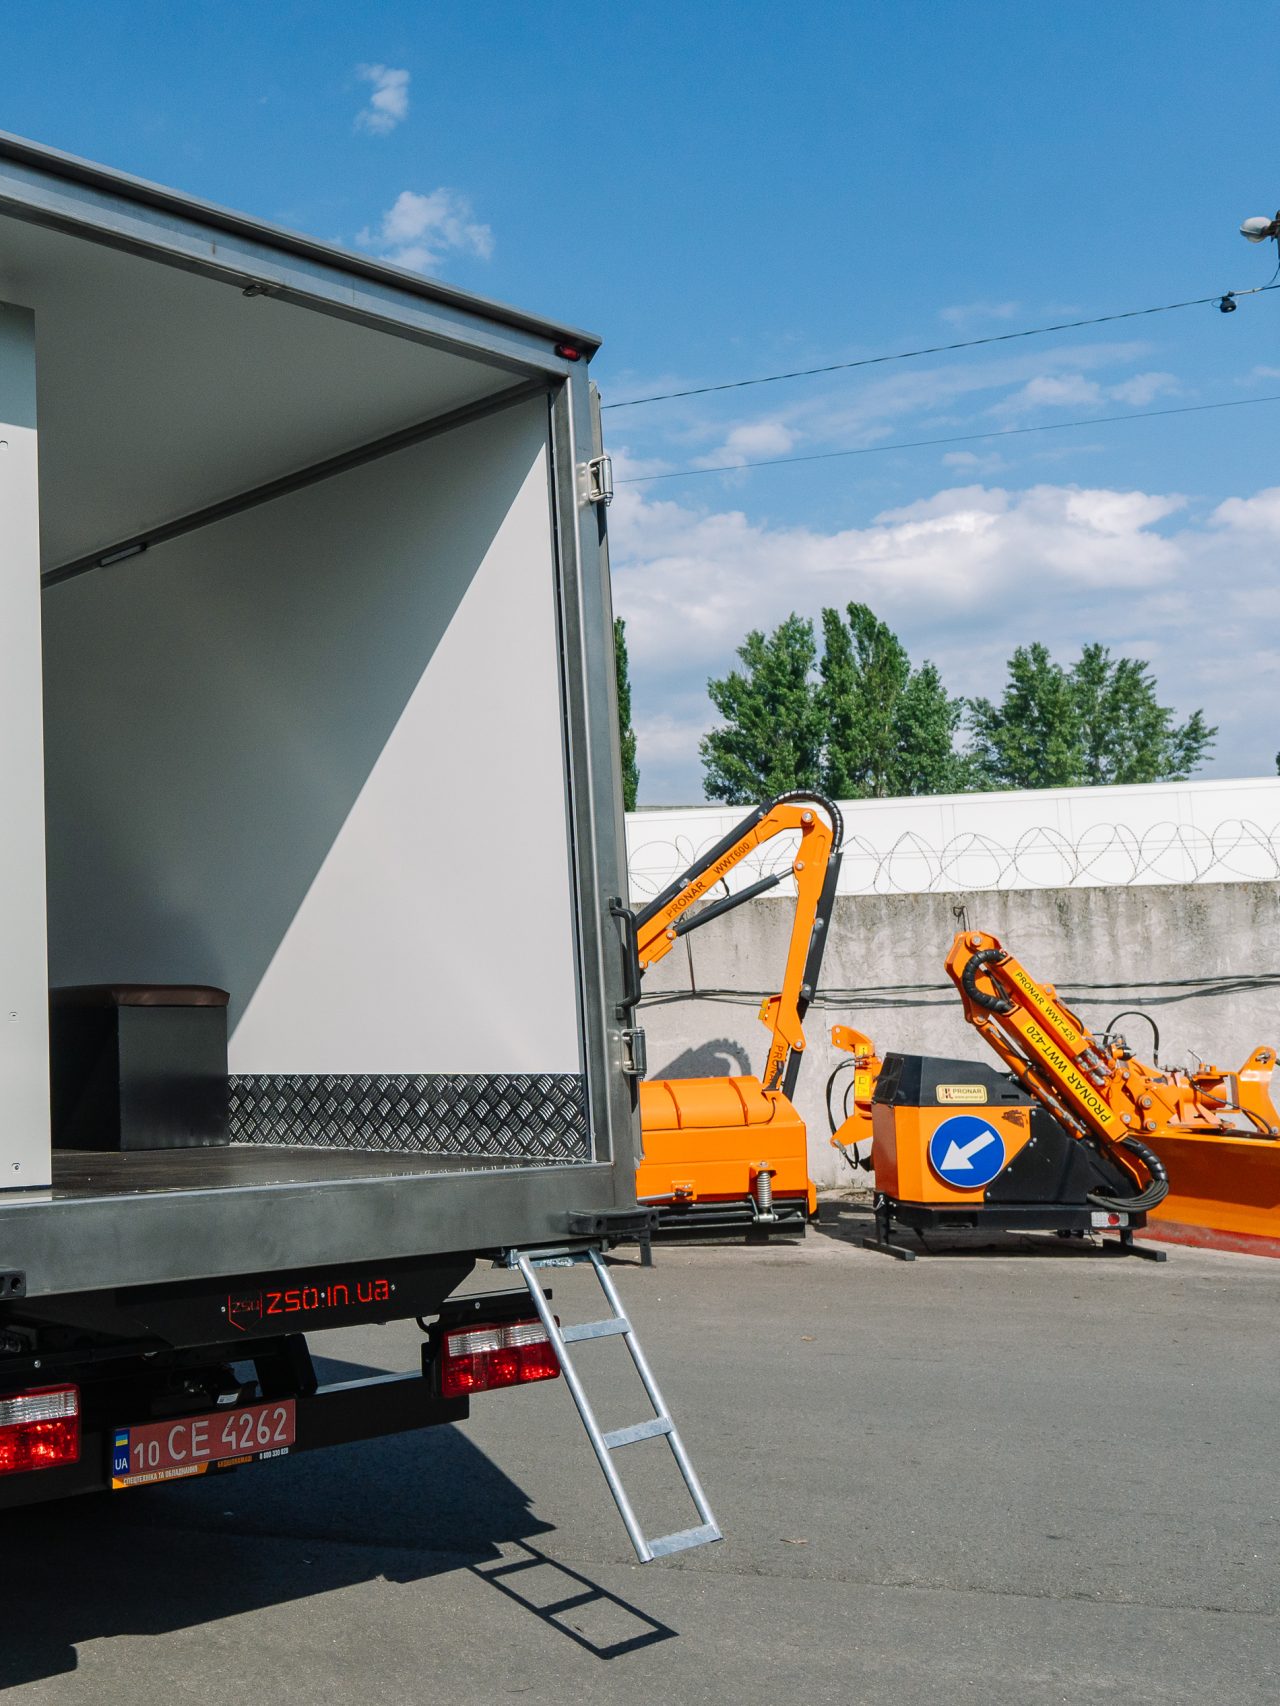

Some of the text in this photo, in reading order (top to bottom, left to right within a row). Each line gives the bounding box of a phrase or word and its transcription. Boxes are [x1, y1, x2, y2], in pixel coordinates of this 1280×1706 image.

[665, 842, 750, 918] PRONAR WWT600
[1015, 971, 1045, 1005] PRONAR
[1067, 1072, 1111, 1123] PRONAR
[133, 1407, 288, 1469] 10 CE 4262
[115, 1457, 128, 1471] UA
